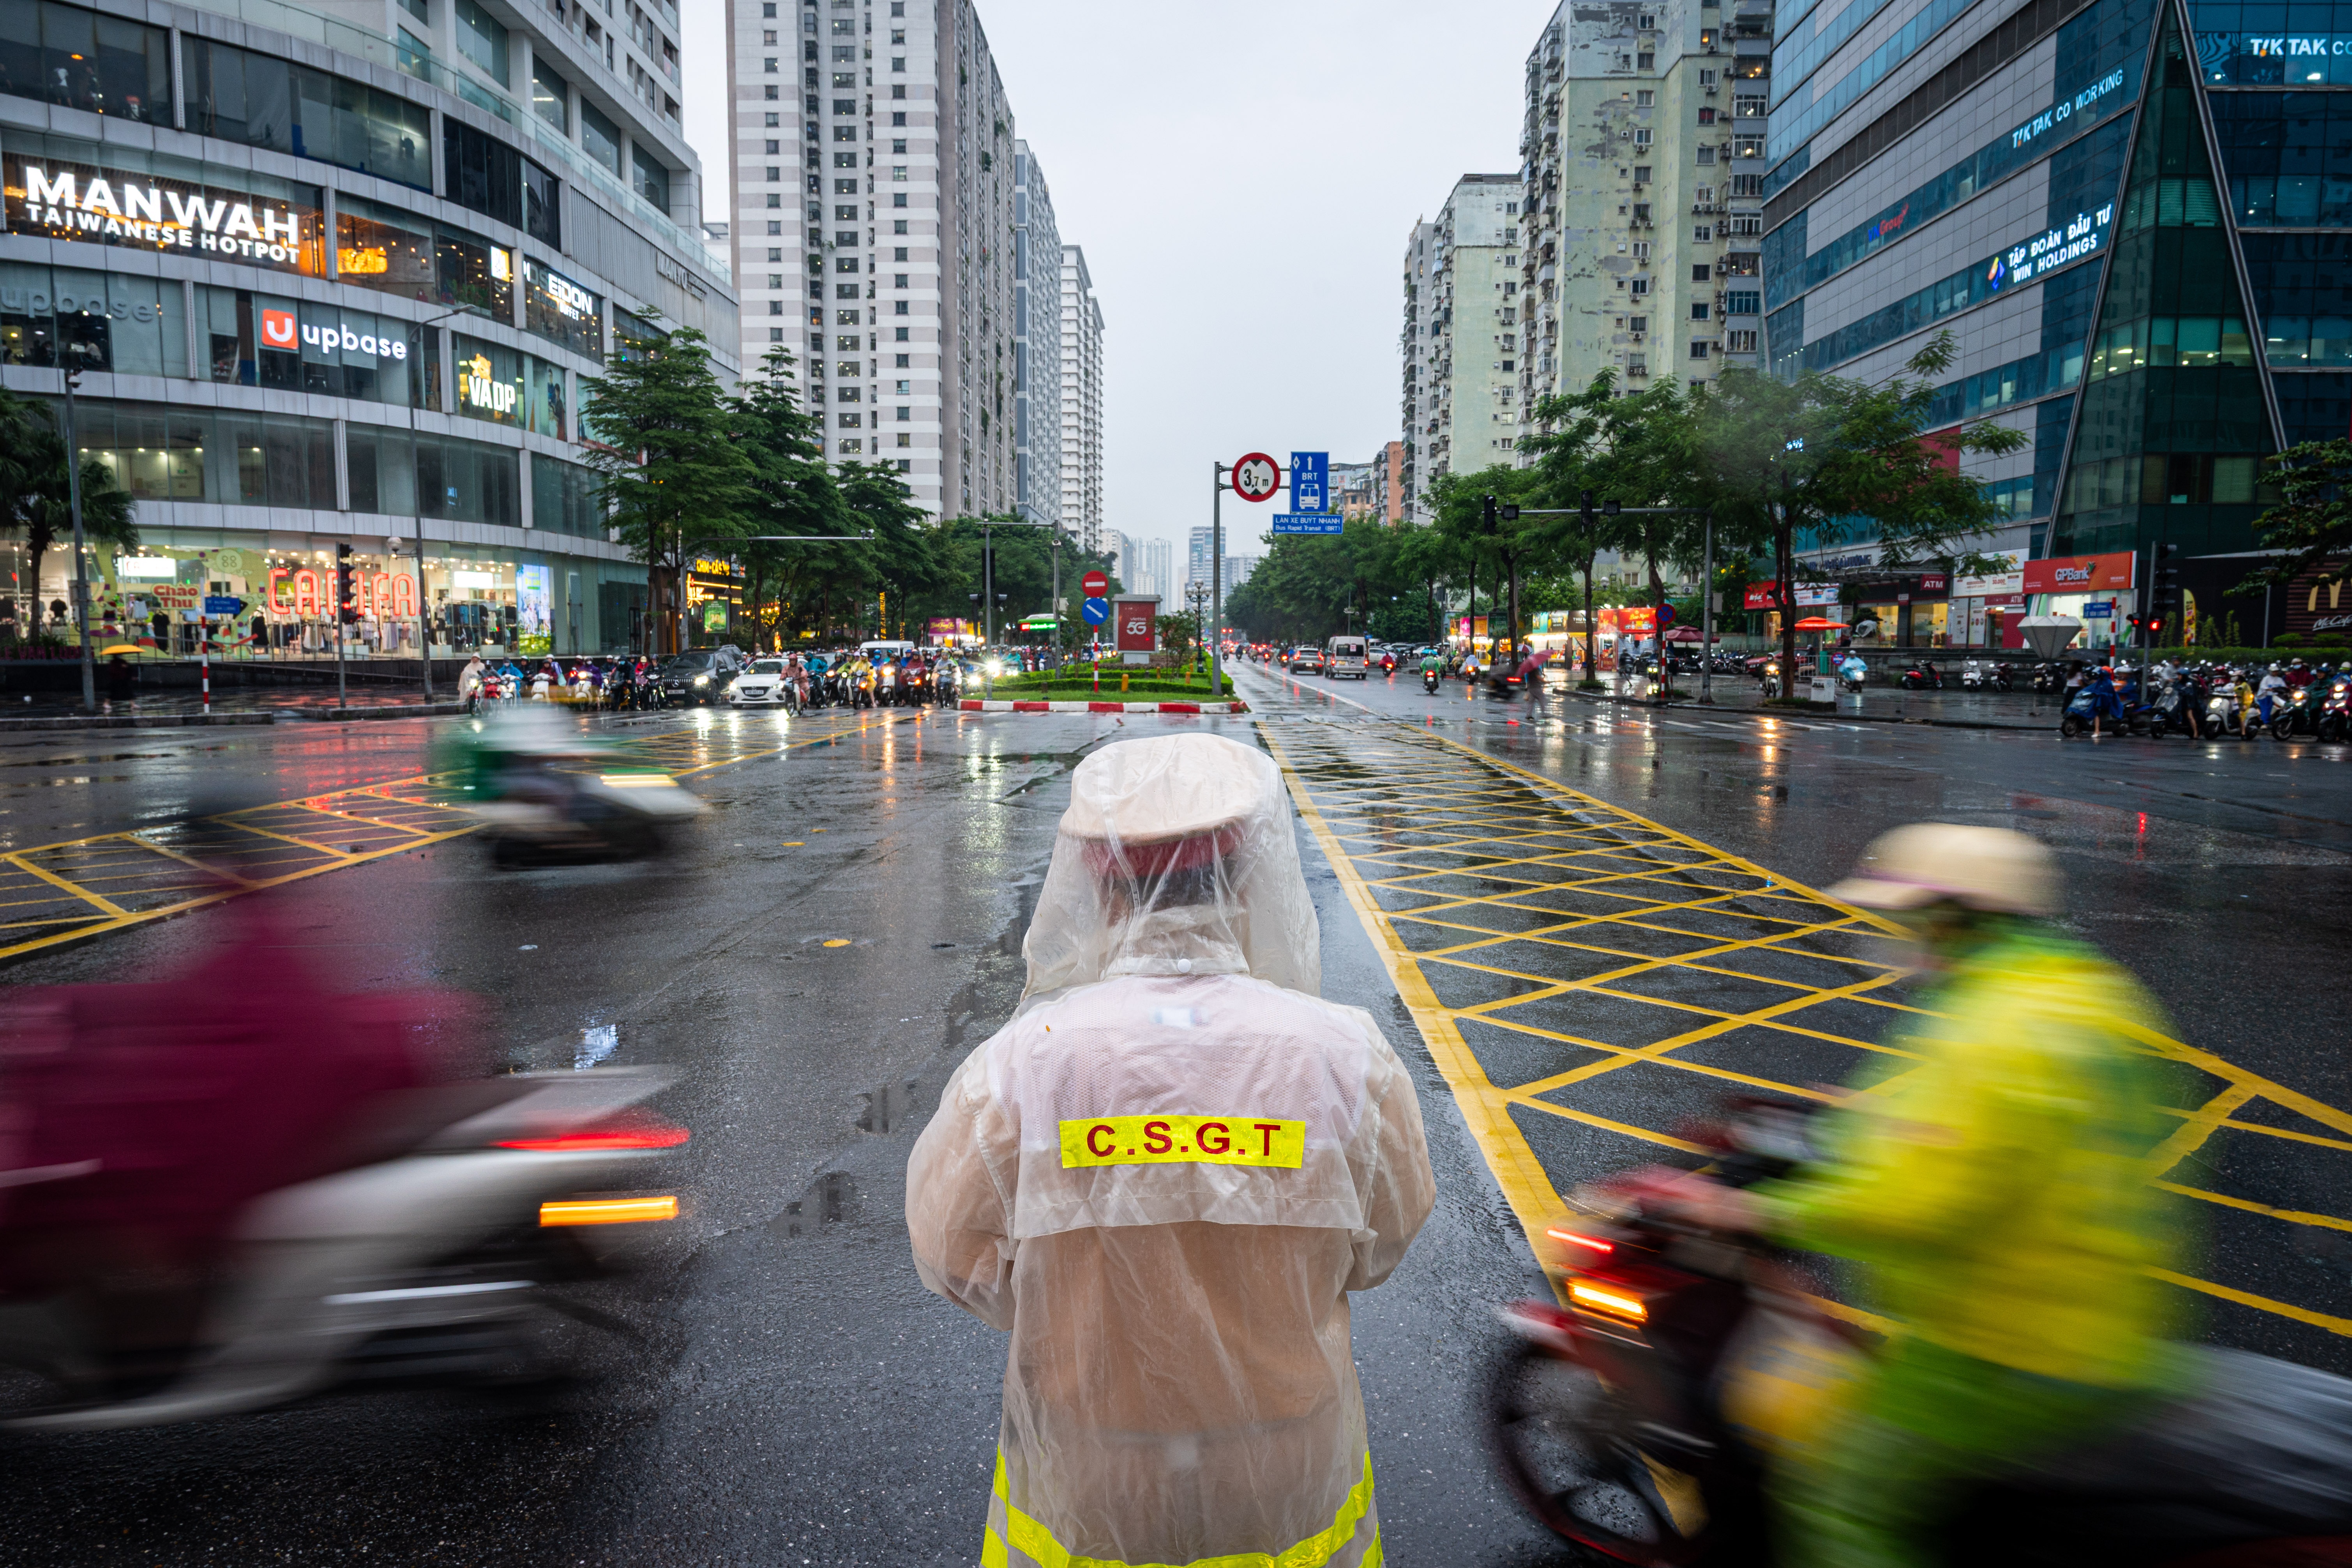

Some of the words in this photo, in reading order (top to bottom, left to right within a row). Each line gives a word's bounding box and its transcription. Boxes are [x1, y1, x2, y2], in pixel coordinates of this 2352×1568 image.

[2288, 39, 2327, 55] TAK
[2032, 110, 2052, 136] TAK
[2057, 102, 2070, 122] CO
[2076, 69, 2122, 111] WORKING
[26, 166, 298, 245] MANWAH
[26, 203, 192, 247] TAIWANESE
[201, 233, 300, 264] HOTPOT
[2009, 246, 2026, 269] TẬP
[2031, 230, 2061, 257] ĐOÀN
[2068, 213, 2090, 240] ĐẦU
[2096, 204, 2111, 226] TƯ
[2013, 263, 2032, 283] WIN
[2038, 233, 2097, 273] HOLDINGS
[1, 283, 154, 323] upbase
[302, 323, 407, 360] upbase
[468, 375, 516, 413] VADP
[1262, 478, 1269, 487] m
[1302, 472, 1318, 480] BRT
[154, 584, 198, 596] Chào
[2055, 567, 2089, 581] GPBank
[160, 597, 192, 608] Thu
[2011, 595, 2022, 604] ATM
[1127, 622, 1147, 635] 5G
[1087, 1121, 1280, 1157] C.S.G.T
